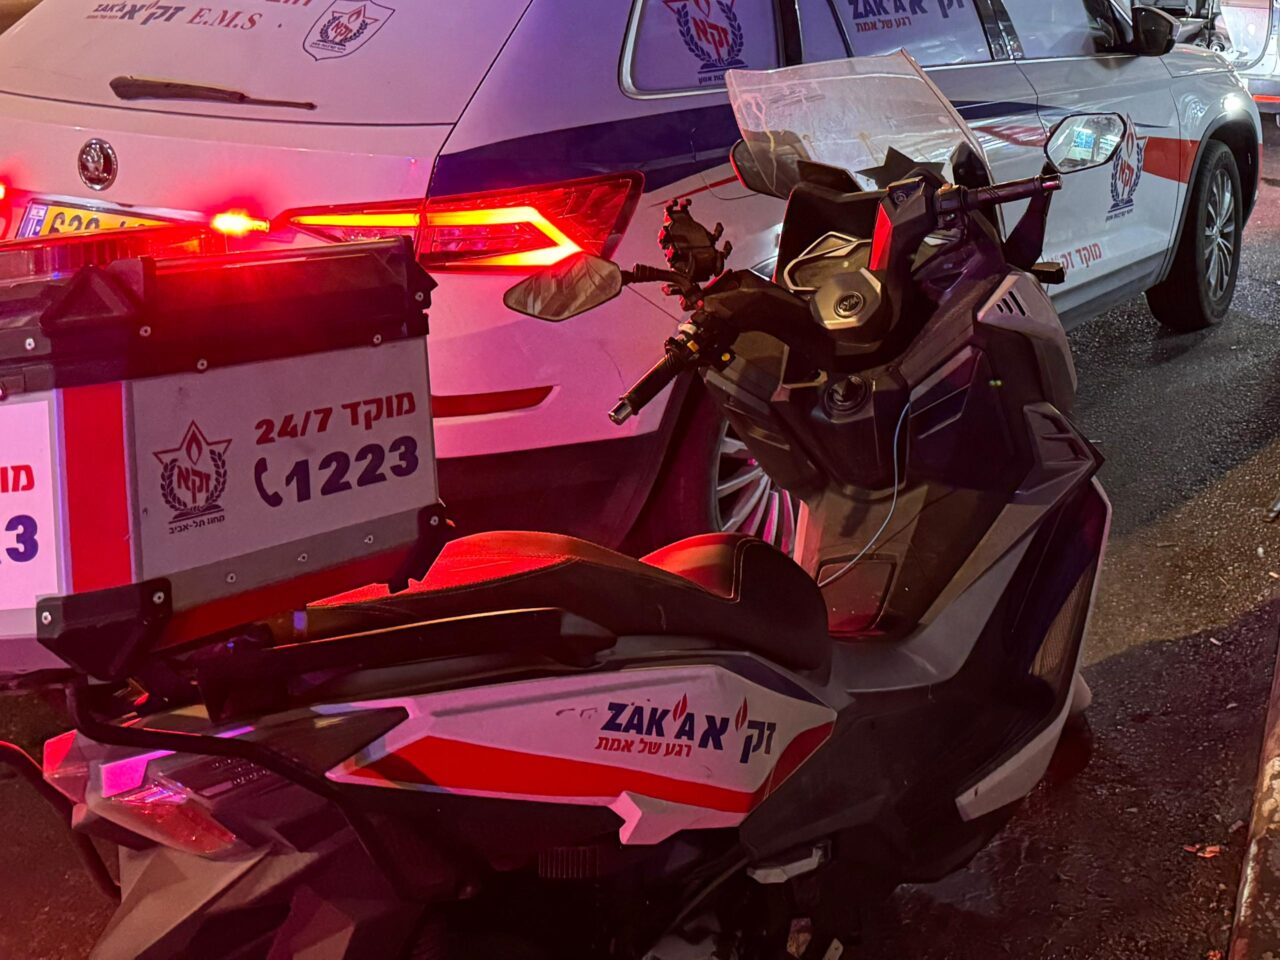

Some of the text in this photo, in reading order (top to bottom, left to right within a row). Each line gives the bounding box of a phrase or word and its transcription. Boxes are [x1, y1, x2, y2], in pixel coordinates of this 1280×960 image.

[855, 16, 912, 33] רגע של אמת
[1075, 242, 1103, 270] מוקד
[255, 392, 416, 445] מוקד 24/7
[0, 464, 36, 494] מו
[284, 435, 419, 503] 1223
[177, 464, 212, 505] זקא
[0, 514, 39, 563] 3
[168, 514, 226, 535] מחוז תל-אביב
[594, 735, 693, 758] רגע של אמת
